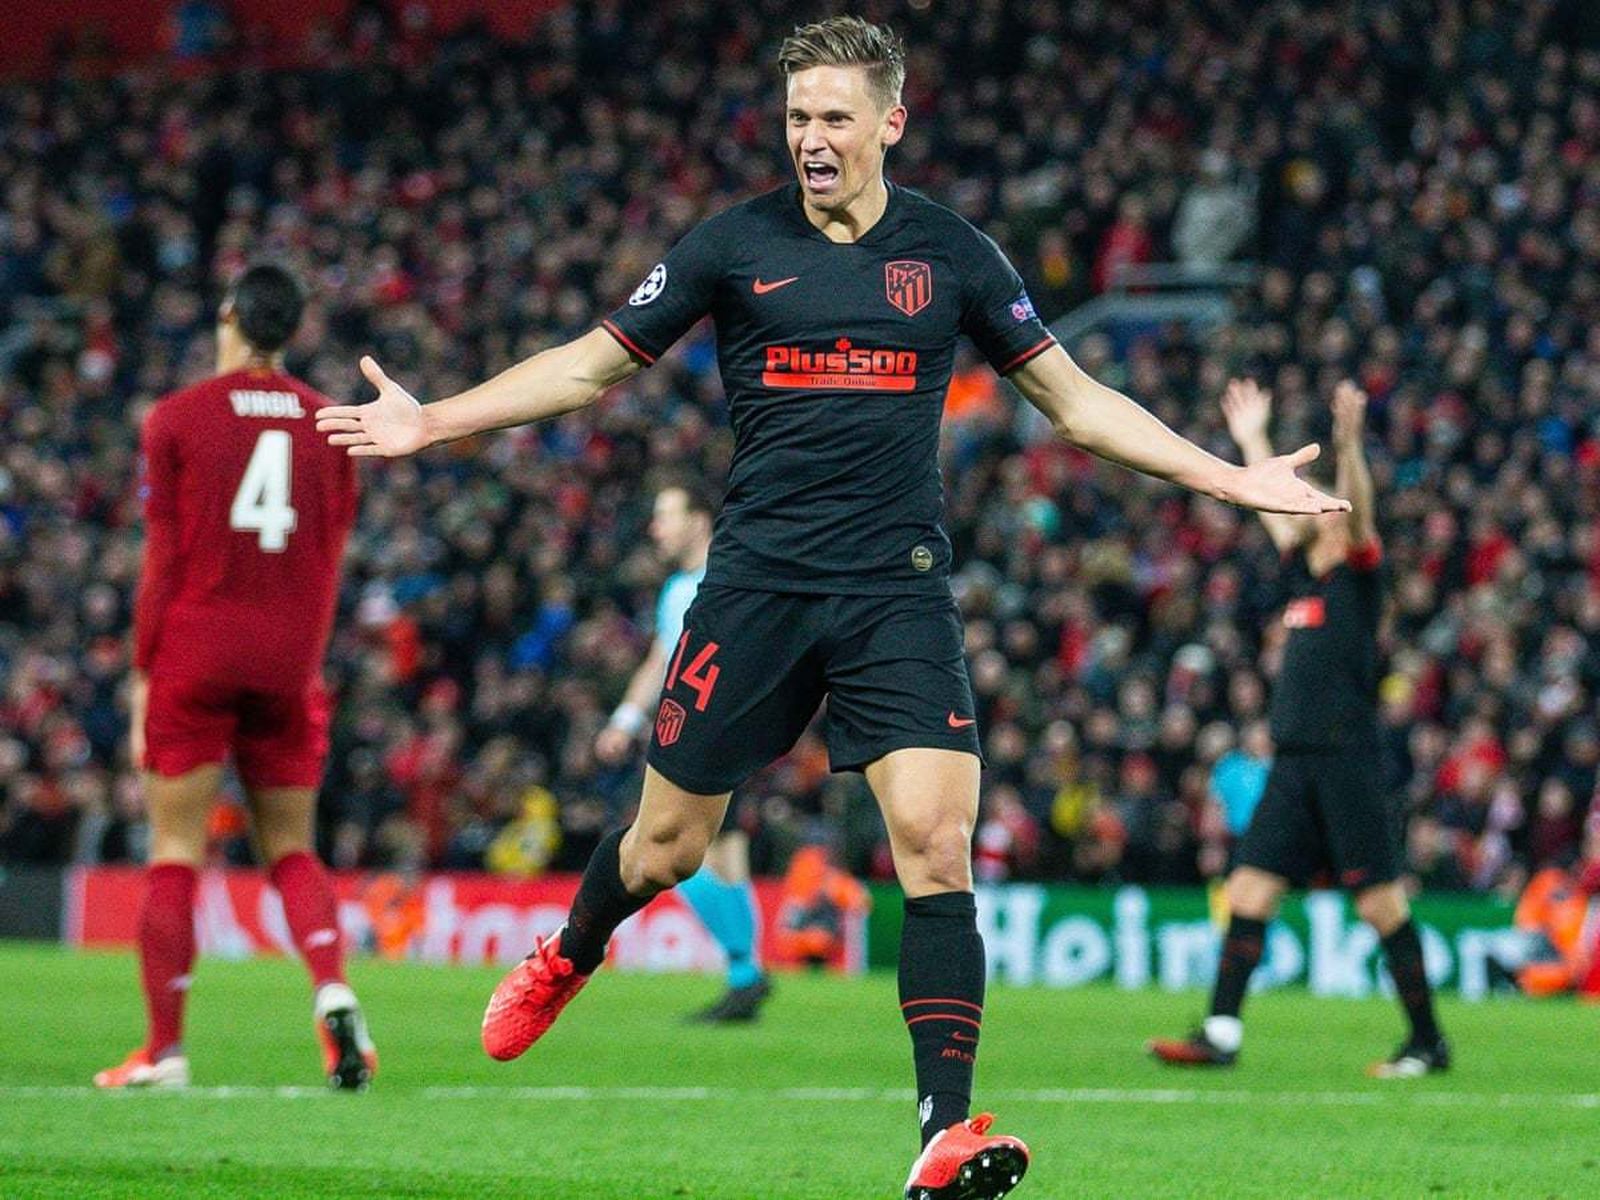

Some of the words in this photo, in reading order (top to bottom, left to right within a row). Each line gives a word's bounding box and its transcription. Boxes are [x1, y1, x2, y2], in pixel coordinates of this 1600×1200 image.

[765, 346, 918, 374] Plus500
[230, 429, 298, 553] 4
[666, 628, 720, 713] 14
